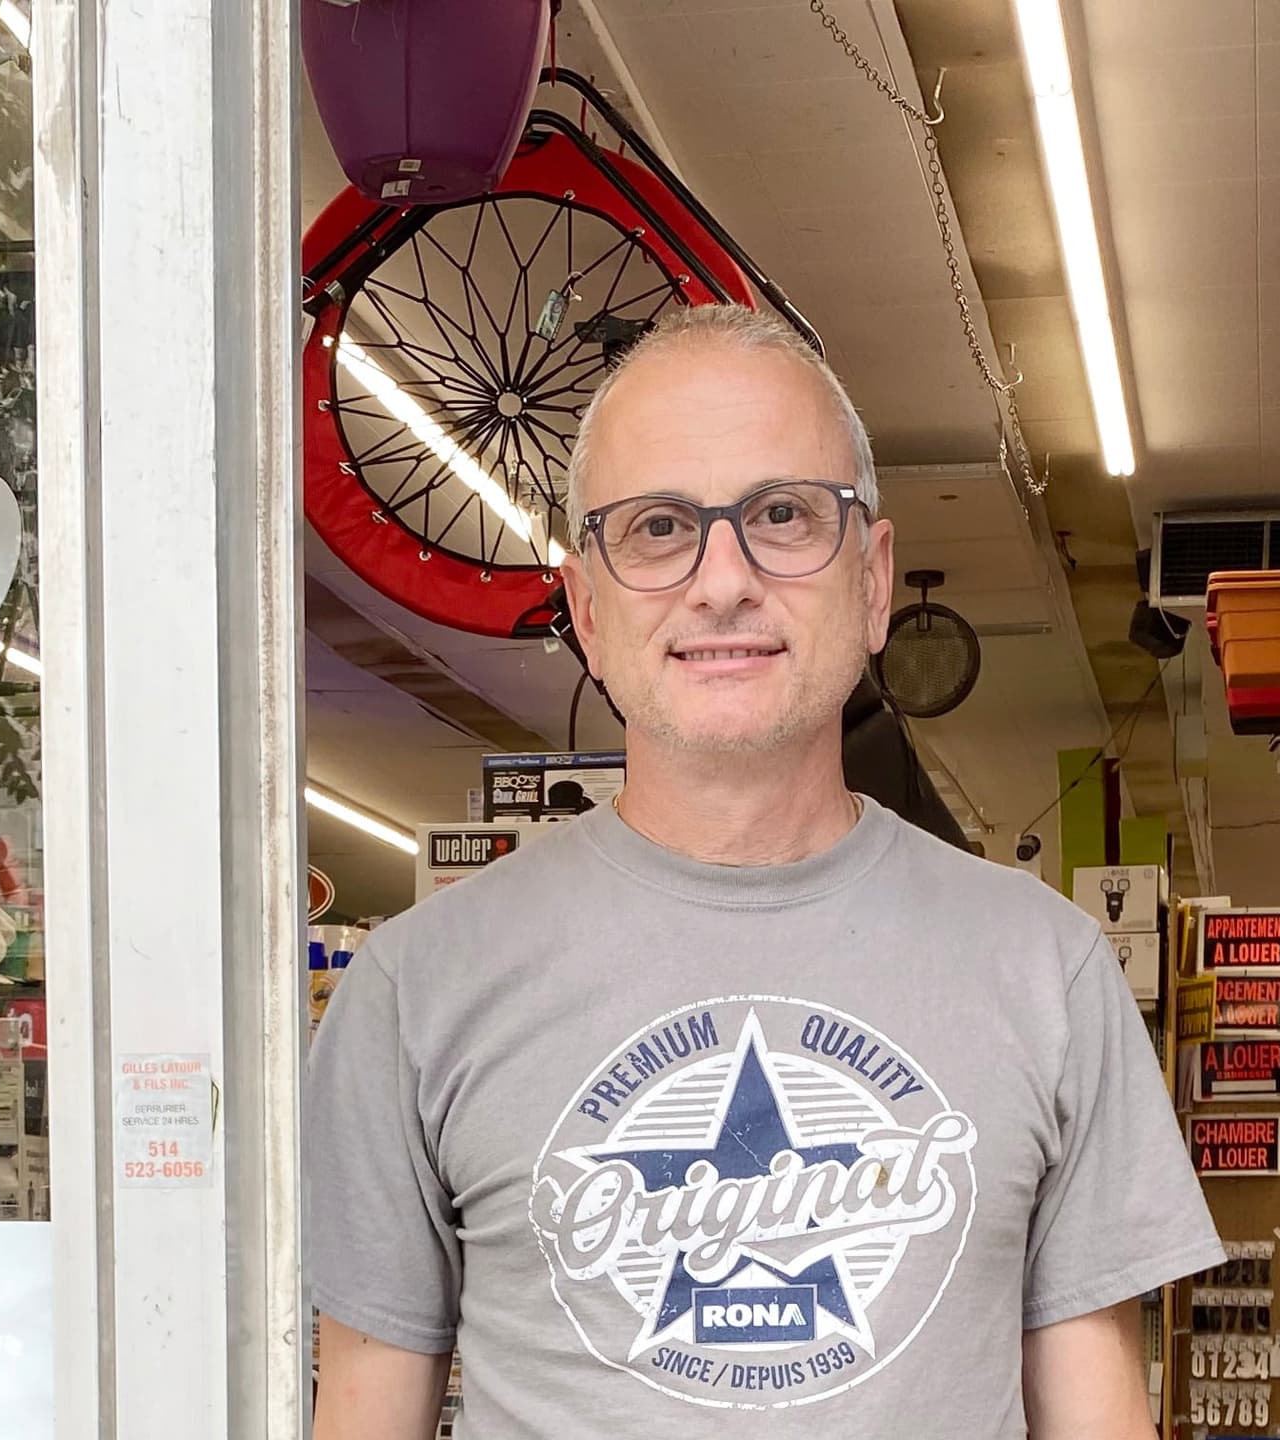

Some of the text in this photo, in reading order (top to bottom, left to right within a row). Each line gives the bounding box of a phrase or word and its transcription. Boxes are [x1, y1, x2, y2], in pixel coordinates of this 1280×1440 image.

[435, 833, 492, 863] weber
[1214, 943, 1280, 963] A LOUER
[1226, 1004, 1279, 1026] LOUER
[576, 1011, 925, 1123] PREMIUM QUALITY
[1205, 1045, 1218, 1071] A
[122, 1116, 160, 1127] SERVICE
[1194, 1119, 1275, 1145] CHAMBRE
[148, 1141, 179, 1157] 514
[1201, 1147, 1269, 1169] A LOUER
[125, 1161, 203, 1178] 523-6056
[531, 1111, 968, 1274] Original
[701, 1302, 807, 1329] RONA
[651, 1346, 715, 1384] SINCE
[730, 1359, 806, 1391] DEPUIS
[806, 1341, 857, 1378] 1939
